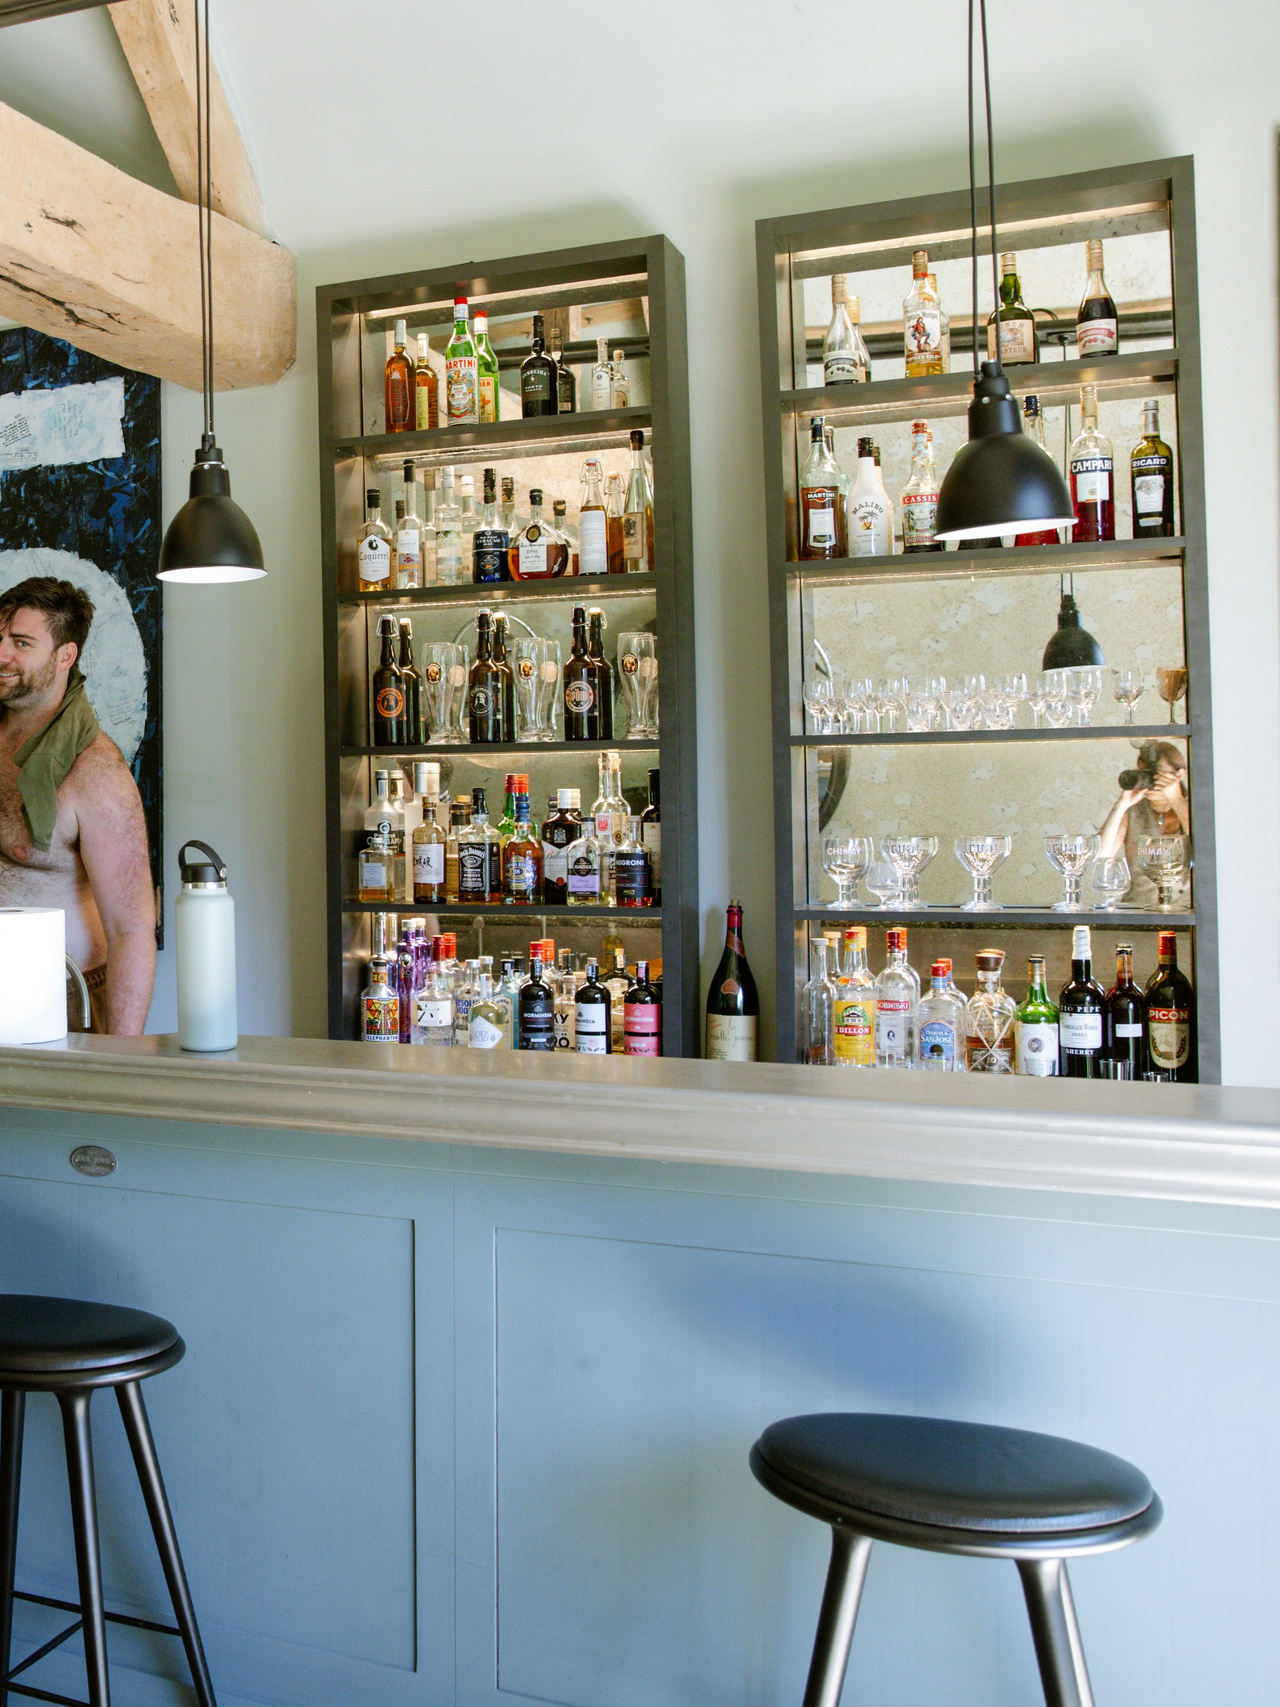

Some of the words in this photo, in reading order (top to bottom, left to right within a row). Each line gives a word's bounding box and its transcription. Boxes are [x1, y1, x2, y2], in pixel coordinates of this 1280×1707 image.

[1072, 460, 1112, 472] CAMPARI
[1132, 458, 1167, 467] RICARD
[905, 494, 937, 503] CASSIS
[852, 502, 884, 515] MALIBU
[1149, 1010, 1188, 1020] PICON
